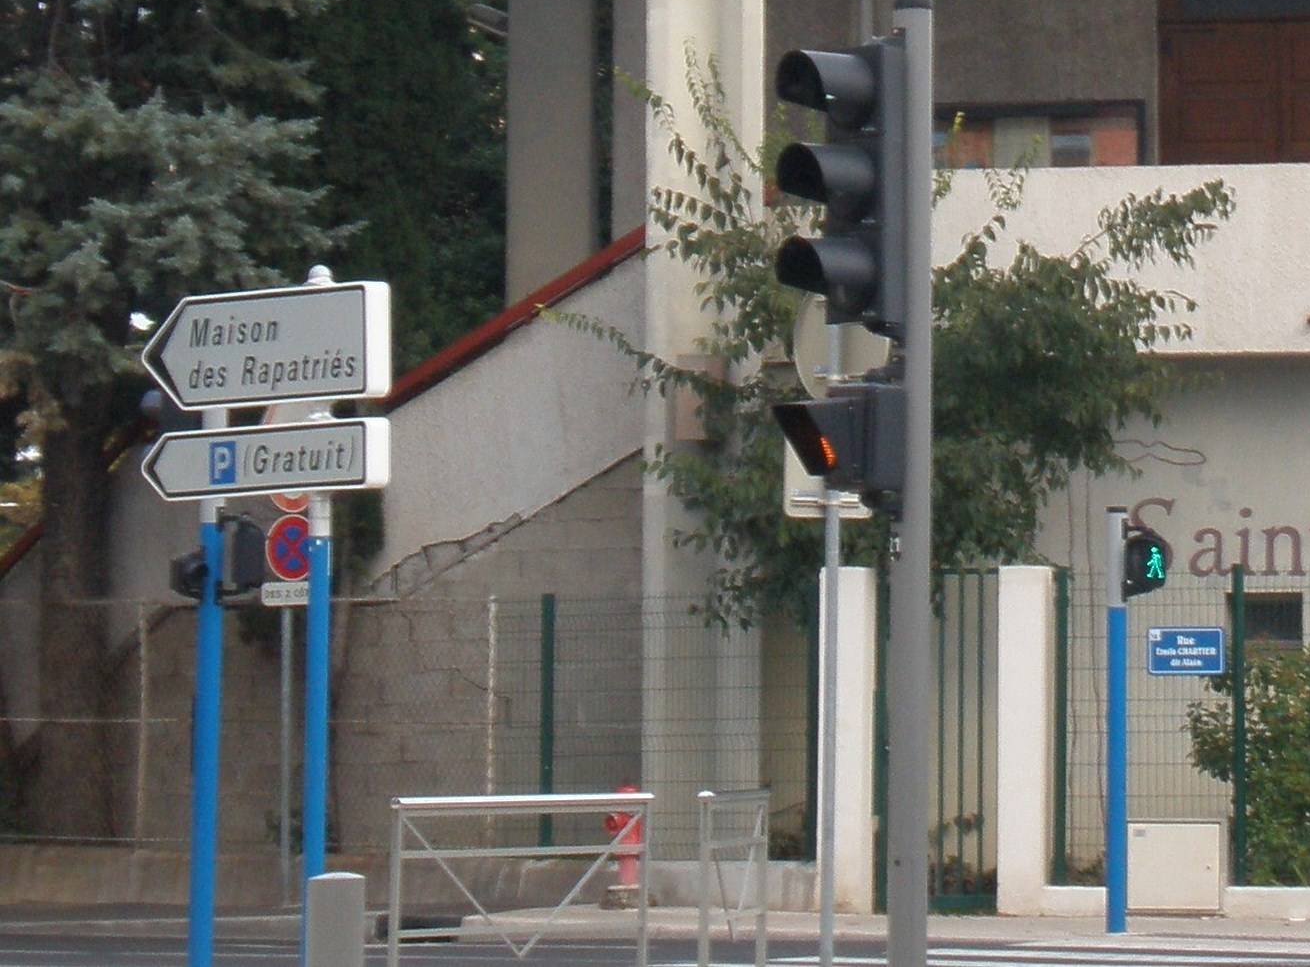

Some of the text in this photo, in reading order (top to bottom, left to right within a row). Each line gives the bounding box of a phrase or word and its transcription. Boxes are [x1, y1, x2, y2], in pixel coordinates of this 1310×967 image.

[189, 316, 279, 348] Maison
[189, 349, 357, 390] des Rapatriés
[212, 437, 357, 480] P (Gratuit)
[1176, 635, 1196, 645] Rue
